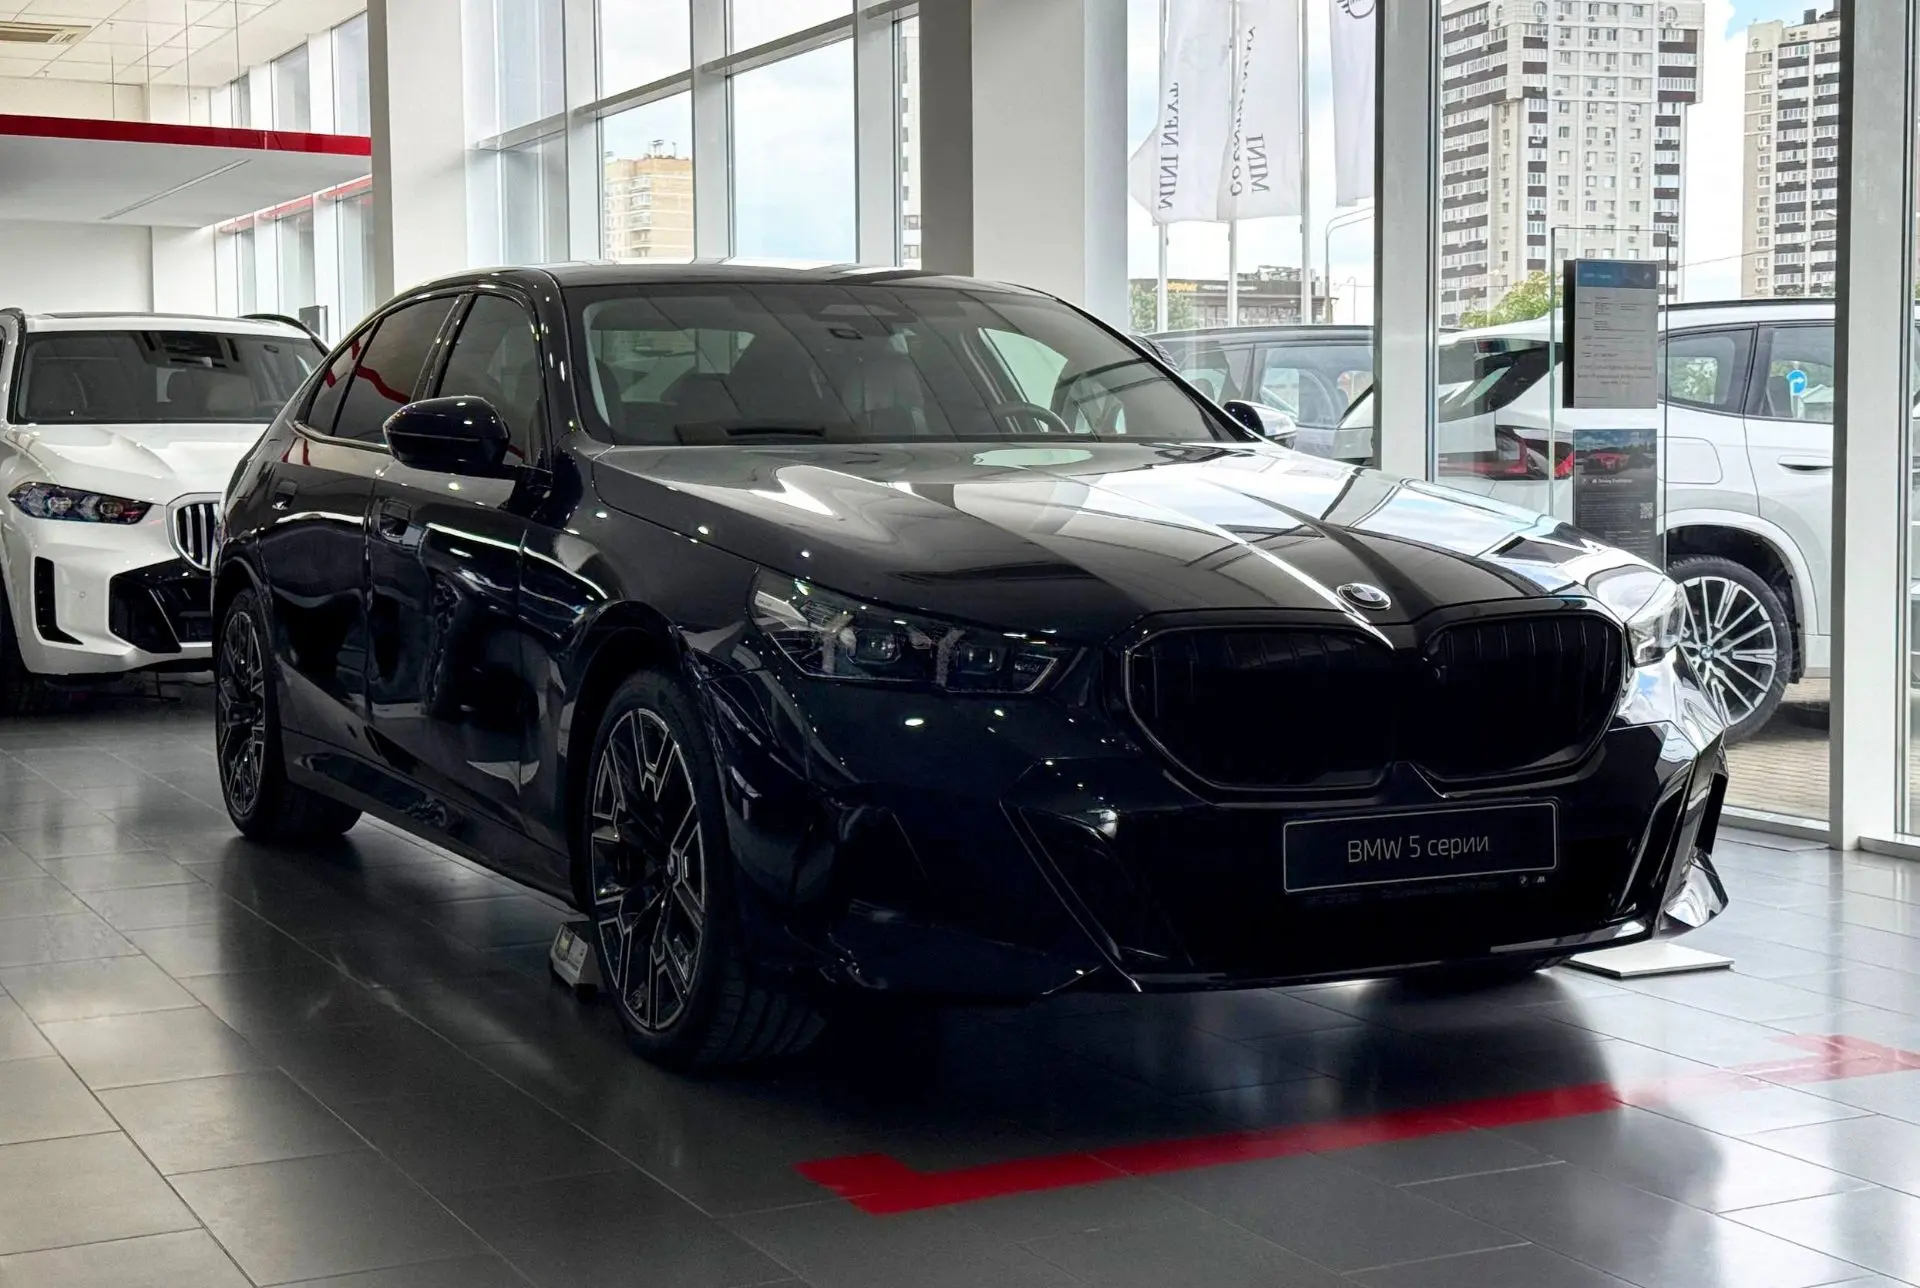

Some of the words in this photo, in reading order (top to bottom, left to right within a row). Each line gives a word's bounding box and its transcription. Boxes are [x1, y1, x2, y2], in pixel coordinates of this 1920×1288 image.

[1347, 836, 1403, 863] BMW
[1409, 834, 1421, 858] 5
[1427, 835, 1490, 860] серии
